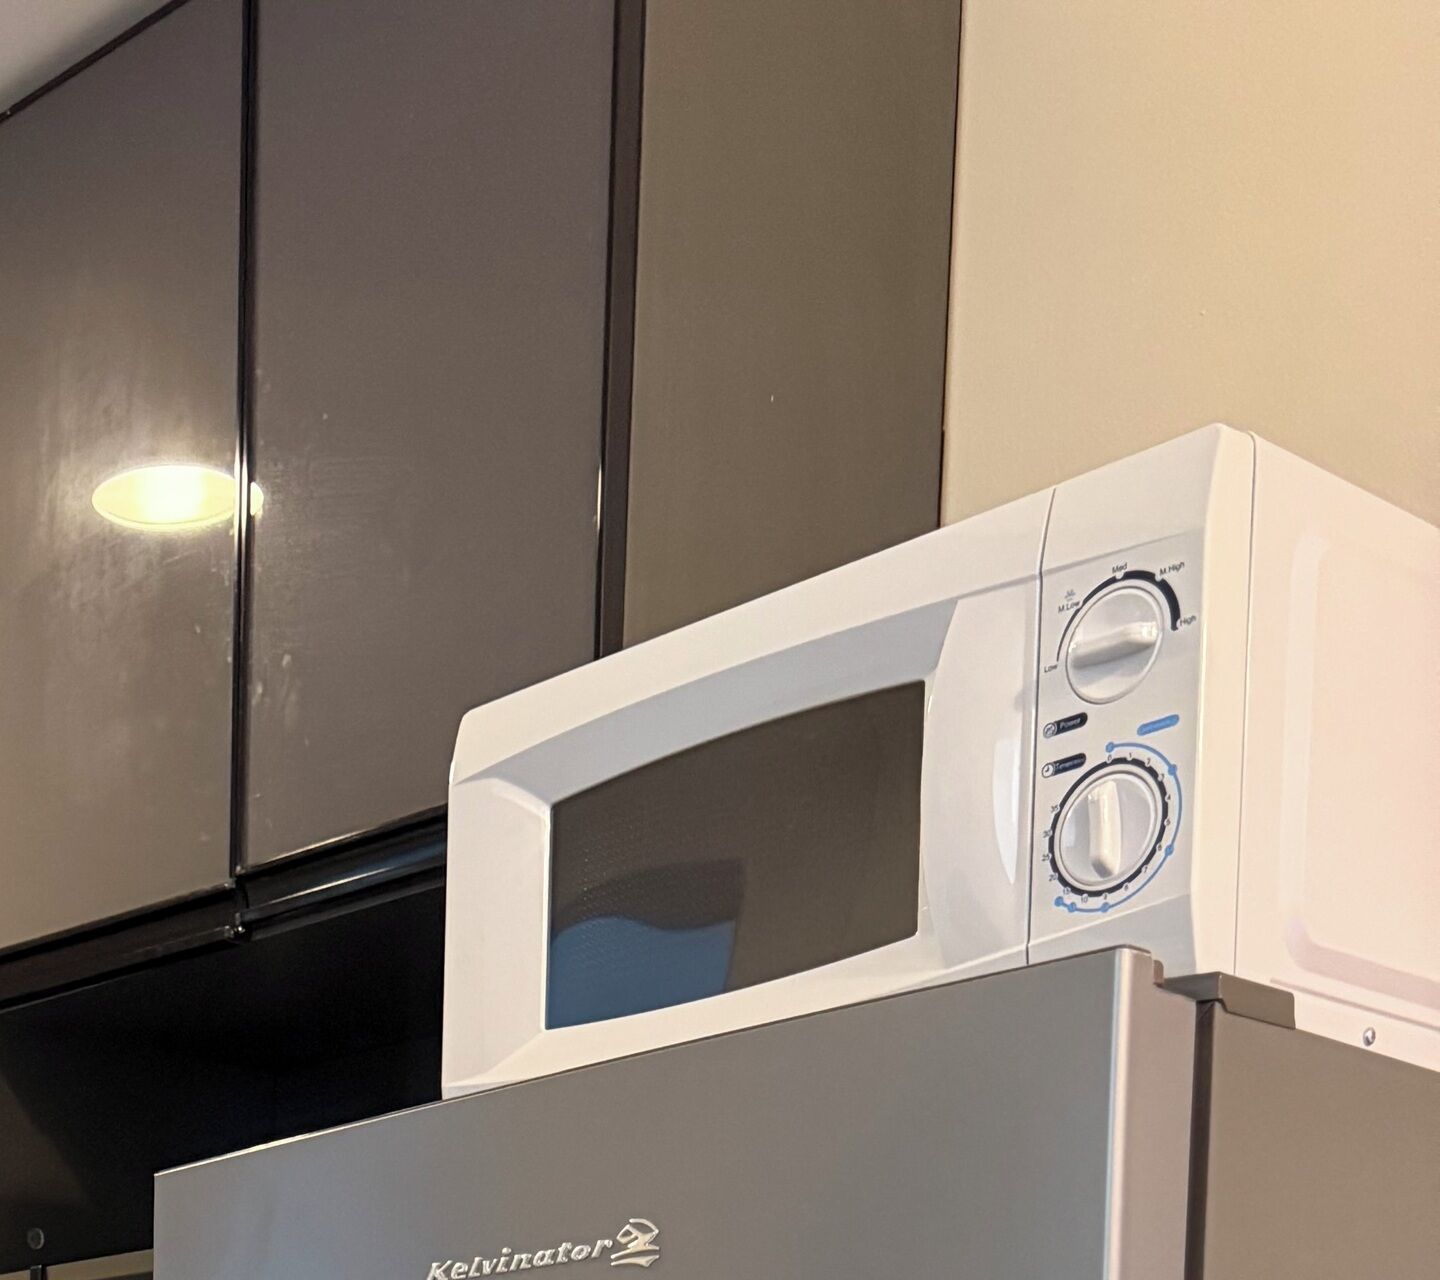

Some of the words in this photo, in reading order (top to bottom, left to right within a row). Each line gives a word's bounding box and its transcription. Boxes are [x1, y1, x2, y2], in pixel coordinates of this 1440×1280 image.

[1112, 562, 1128, 574] Med
[1058, 600, 1080, 614] M.Low
[1179, 615, 1197, 626] High
[1044, 664, 1058, 673] Low
[1060, 718, 1081, 730] Power
